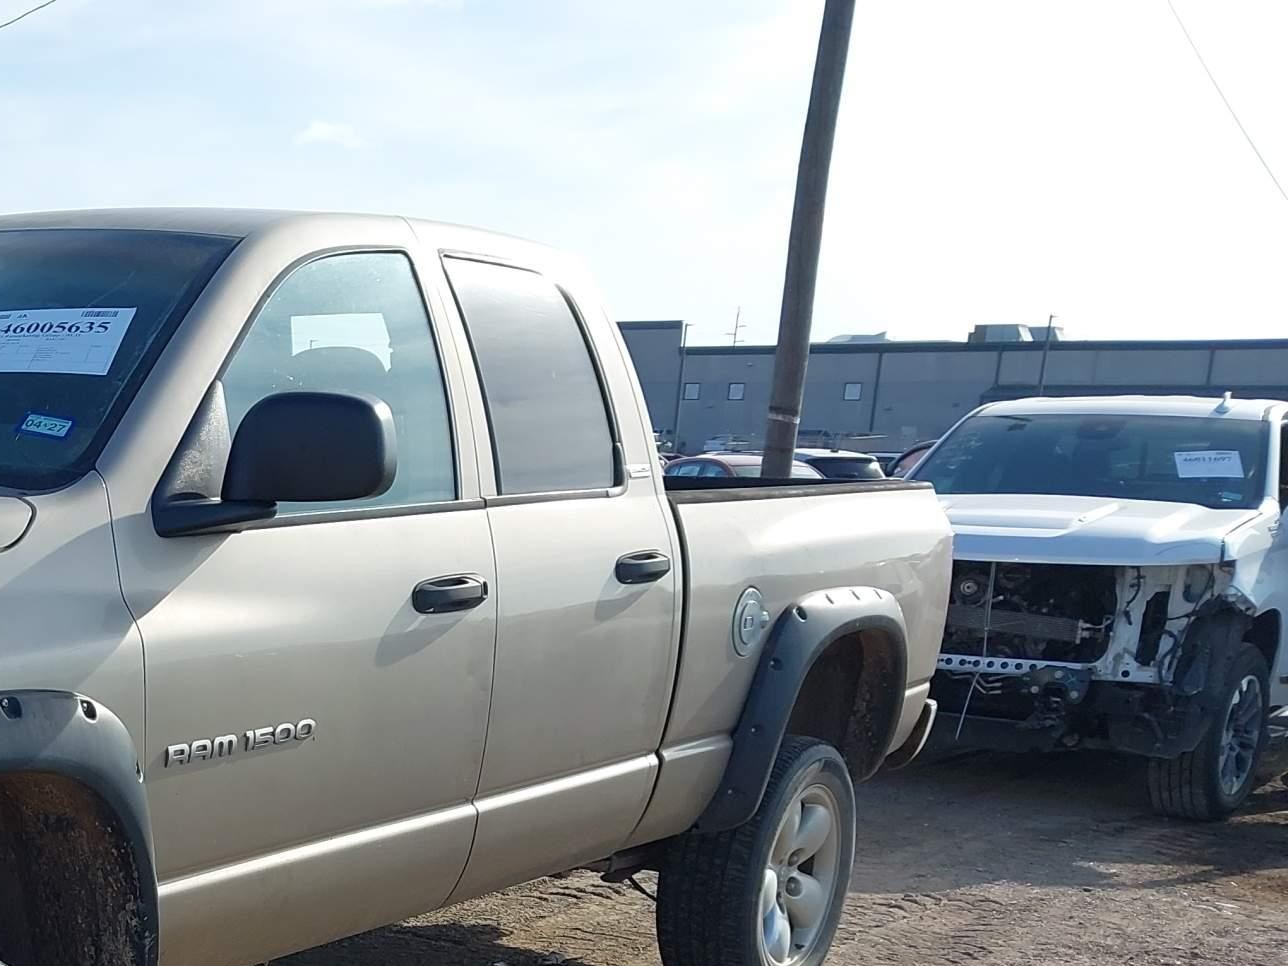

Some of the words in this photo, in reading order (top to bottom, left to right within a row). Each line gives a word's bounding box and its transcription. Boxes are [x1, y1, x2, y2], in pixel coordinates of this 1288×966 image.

[25, 419, 43, 429] 04
[47, 422, 67, 433] 27
[165, 734, 238, 768] RAM
[244, 718, 317, 752] 1500
